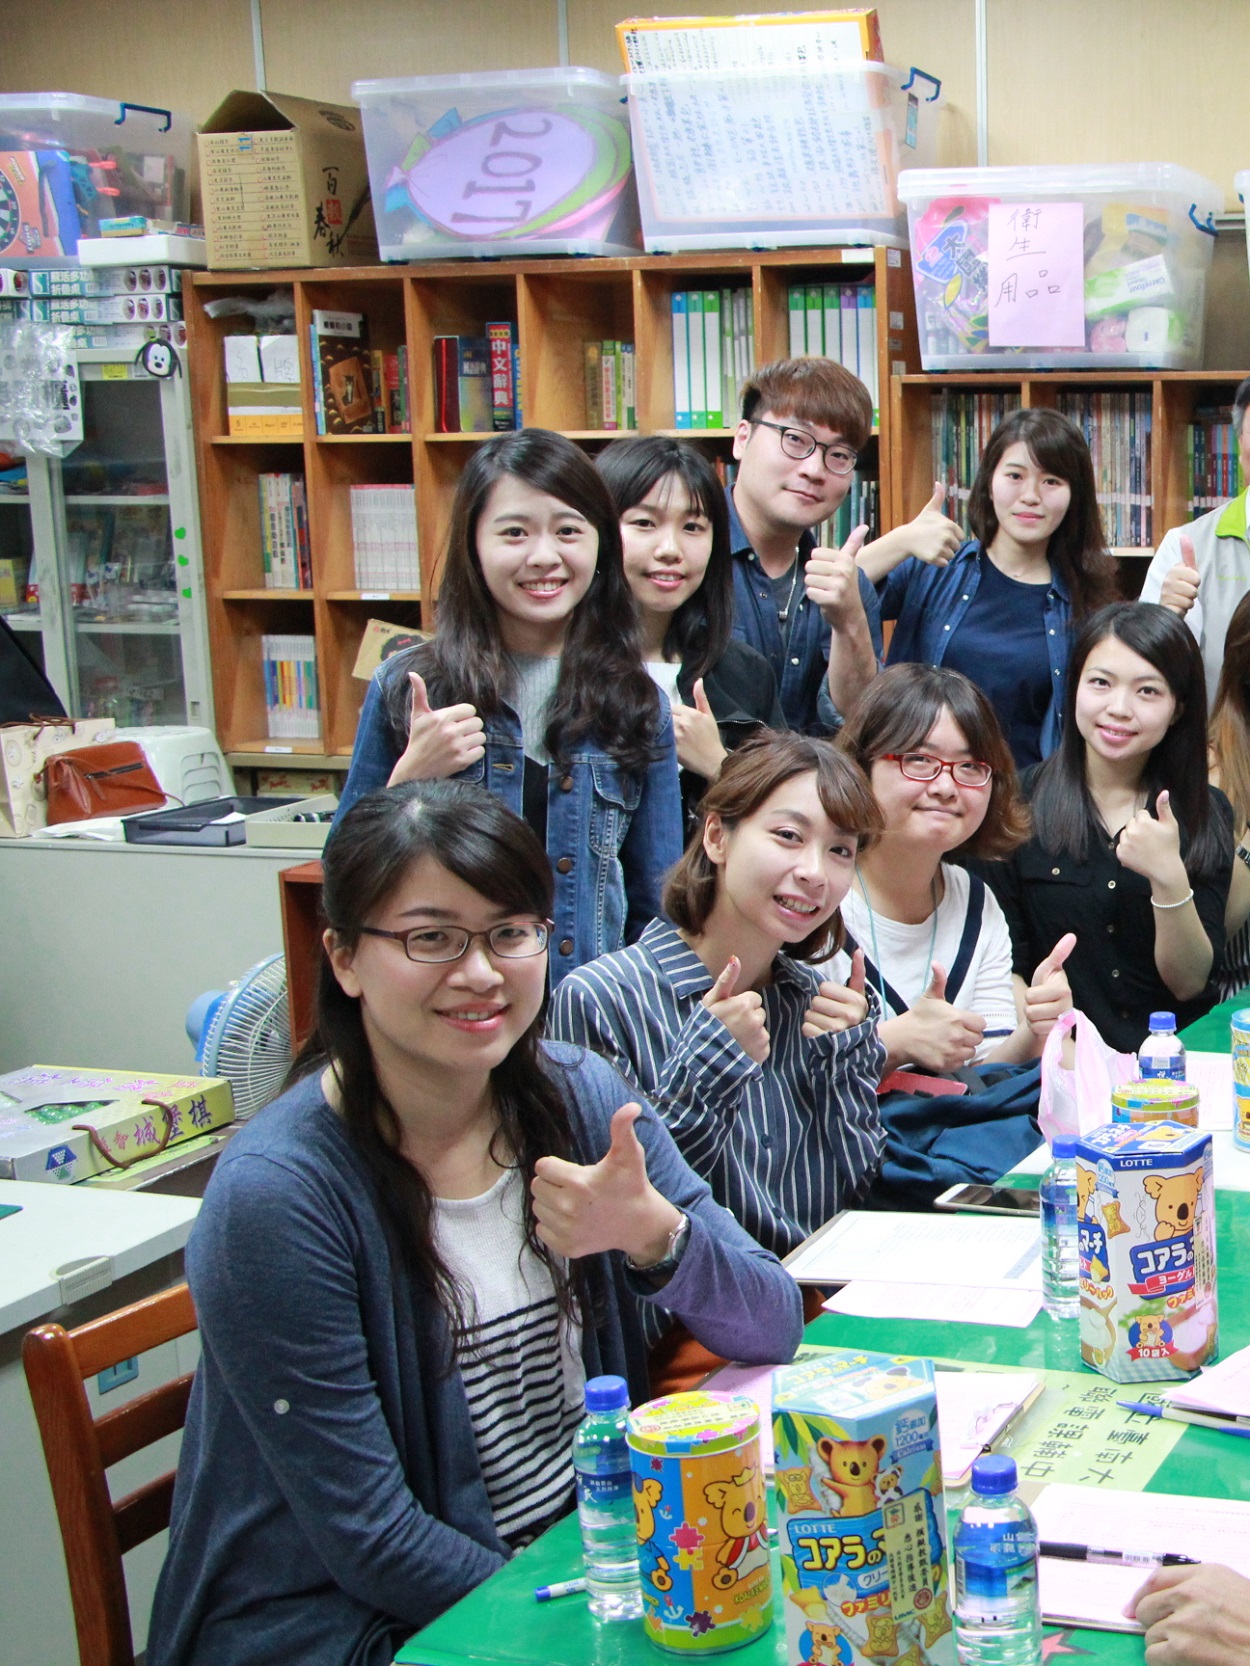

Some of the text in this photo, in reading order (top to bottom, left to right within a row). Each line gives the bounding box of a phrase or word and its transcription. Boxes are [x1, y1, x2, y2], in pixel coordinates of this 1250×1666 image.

[451, 117, 552, 228] 2017
[491, 339, 509, 405] 中文辭典
[1120, 1159, 1153, 1167] LOTTE
[1167, 1289, 1196, 1309] ファミ
[794, 1523, 836, 1534] LOTTE
